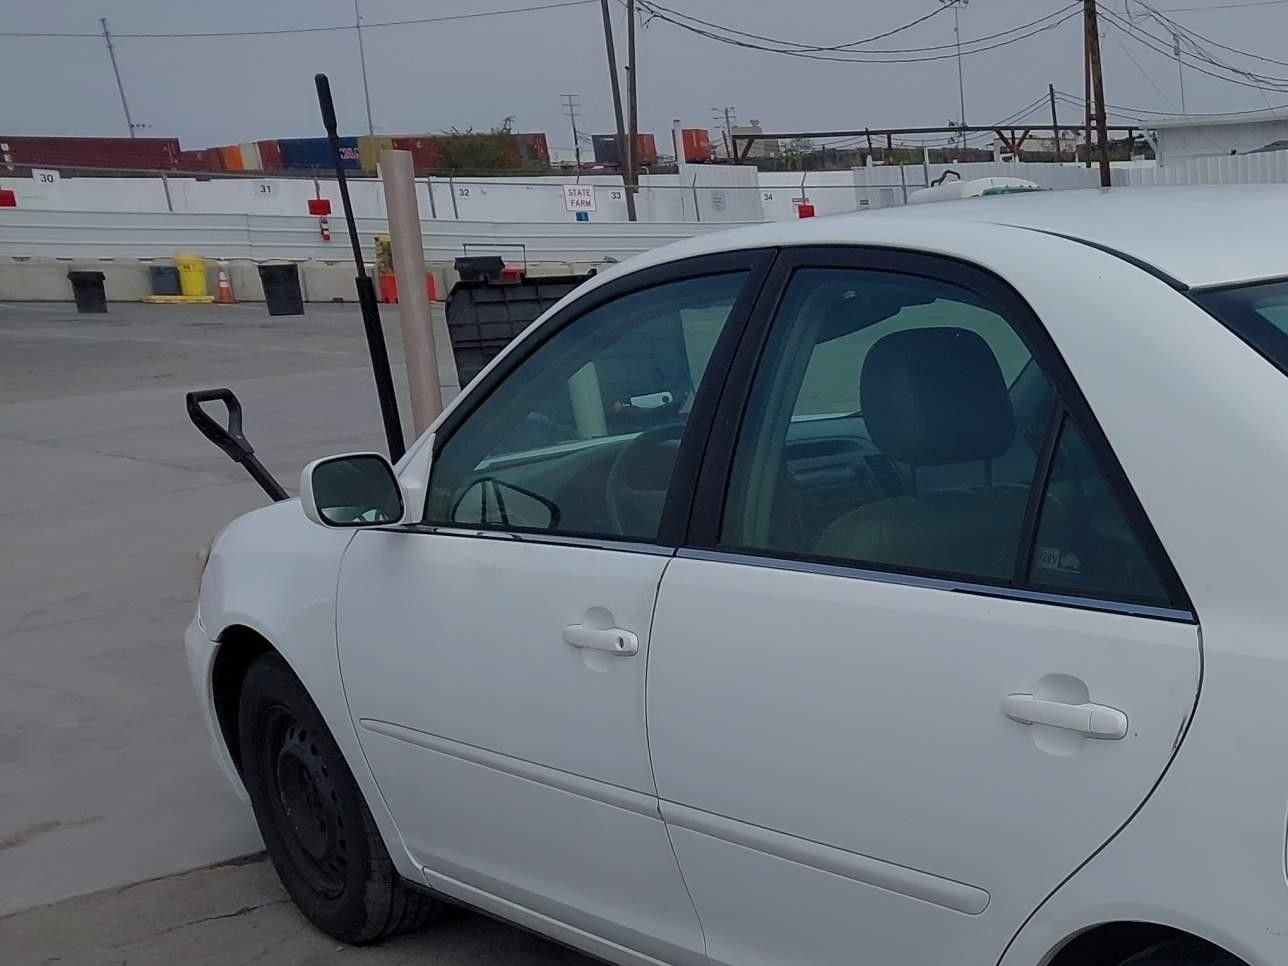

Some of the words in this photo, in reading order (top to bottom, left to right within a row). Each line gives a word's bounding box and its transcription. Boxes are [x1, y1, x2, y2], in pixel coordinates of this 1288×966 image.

[40, 173, 54, 183] 30
[260, 184, 271, 193] 31
[458, 188, 470, 197] 32
[568, 188, 592, 197] STATE
[610, 191, 622, 200] 33
[570, 199, 592, 208] FARM
